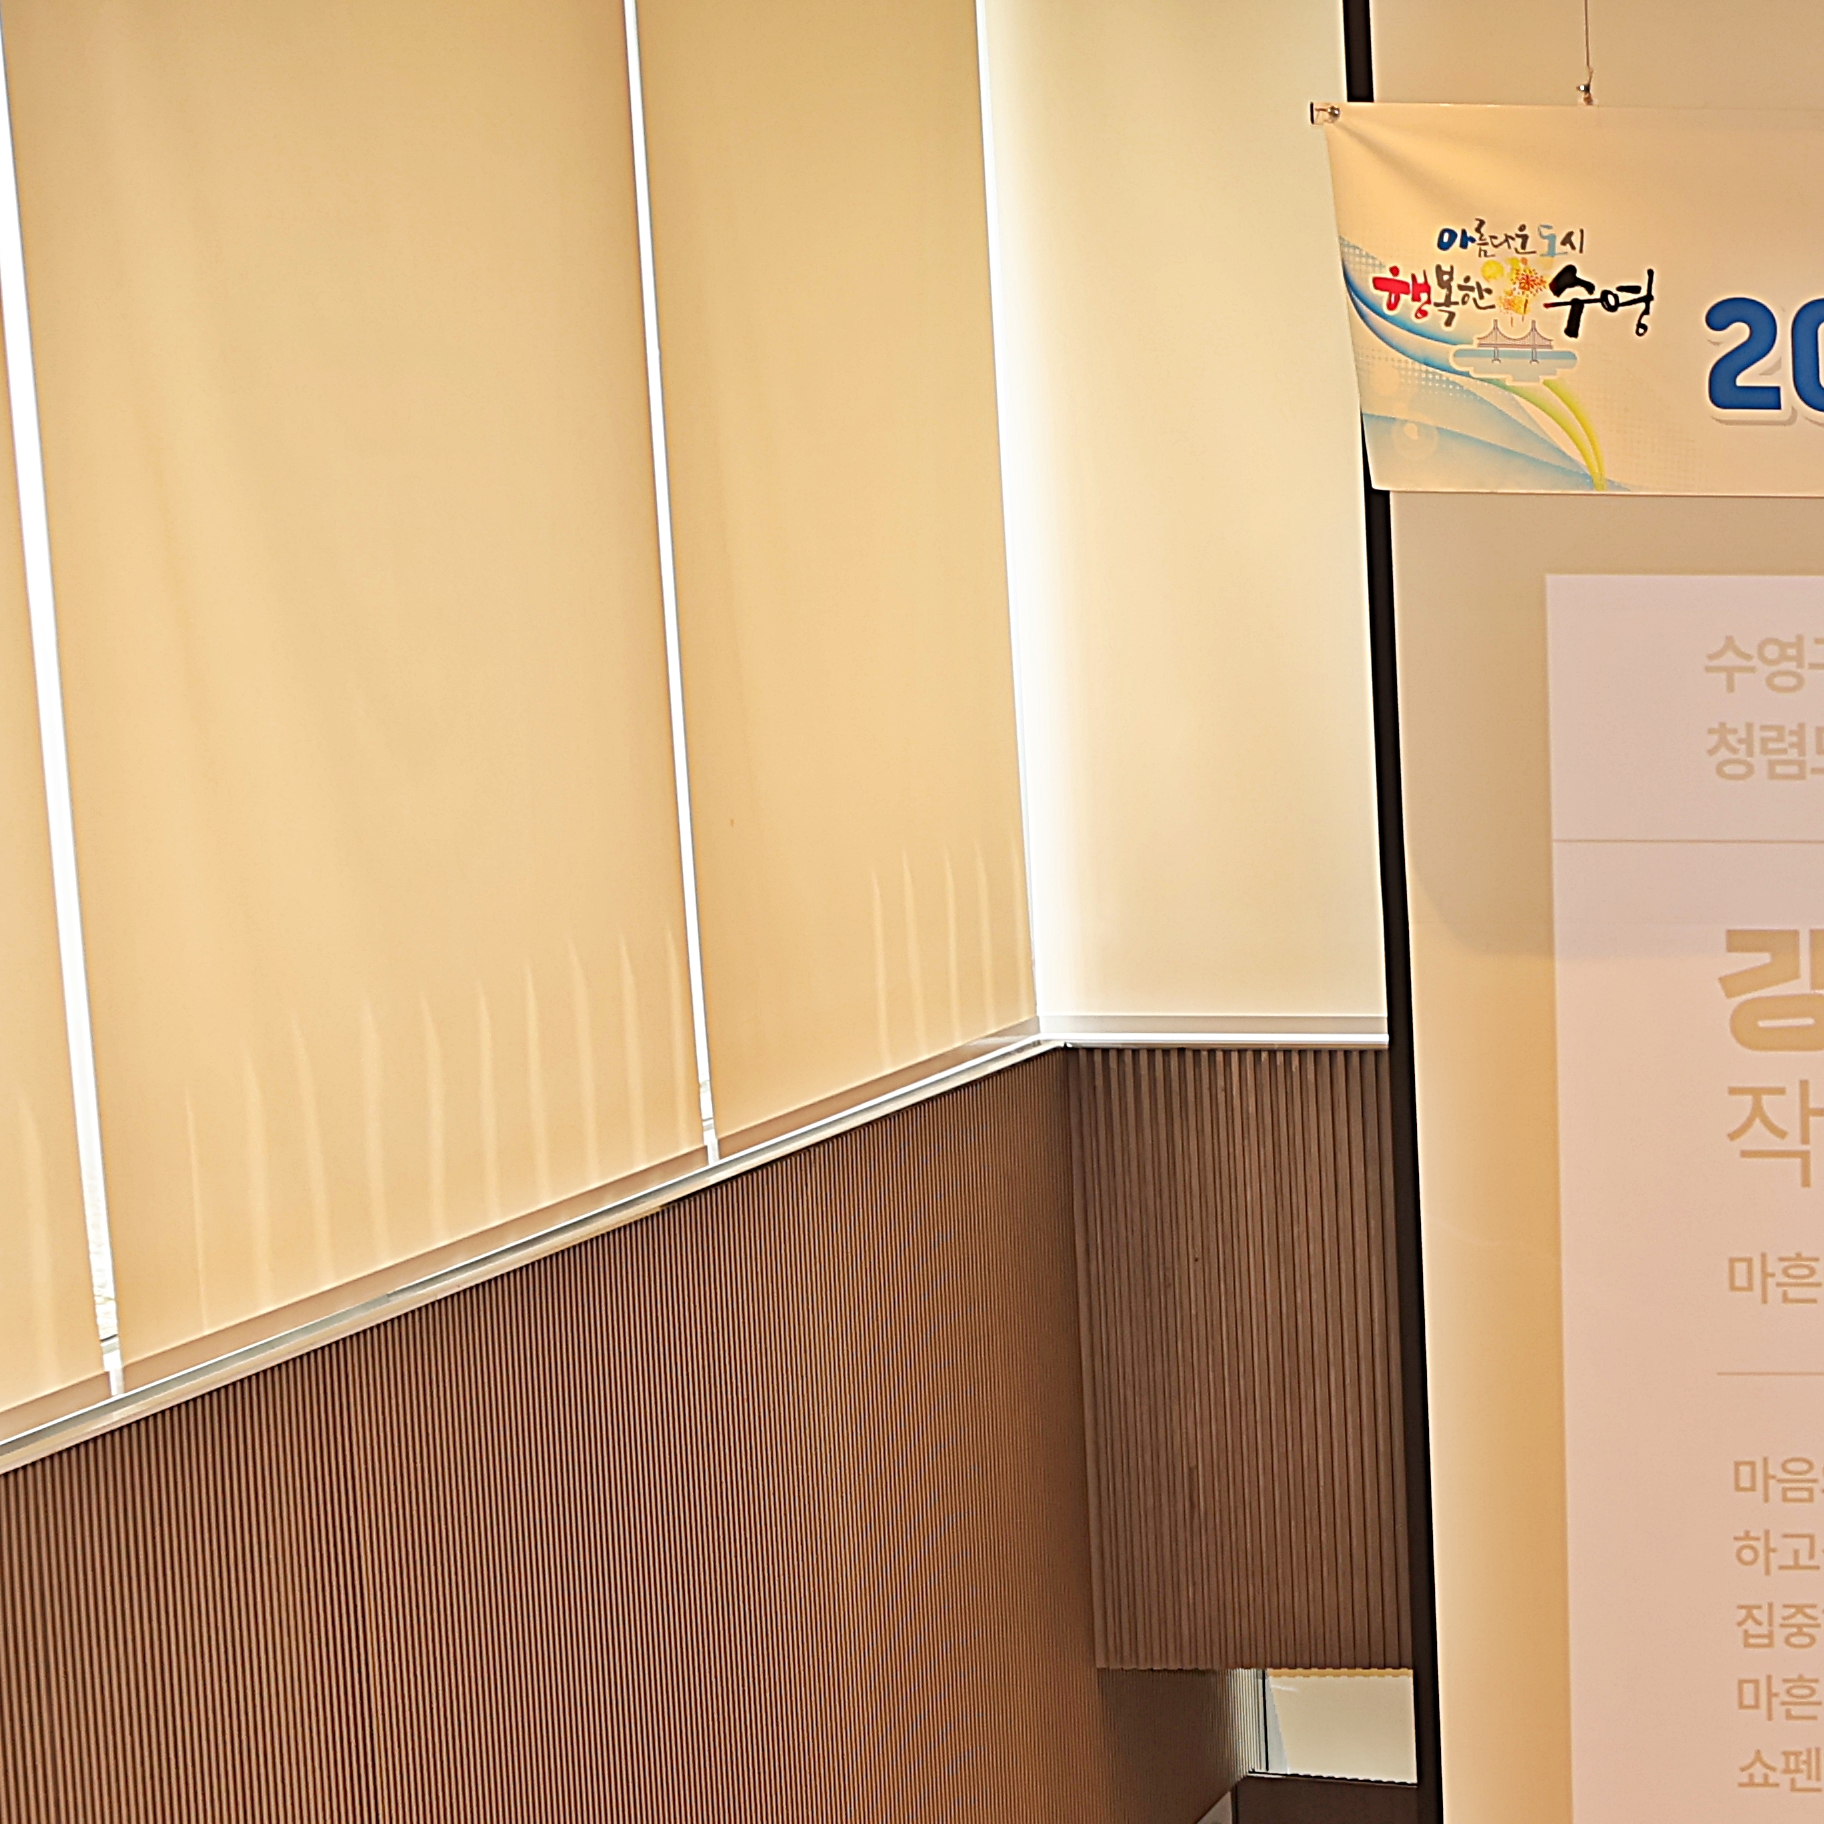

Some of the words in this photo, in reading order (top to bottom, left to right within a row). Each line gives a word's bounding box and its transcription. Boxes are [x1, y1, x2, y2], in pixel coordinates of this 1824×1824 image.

[1436, 217, 1537, 259] 아름다운
[1537, 224, 1585, 258] 도시
[1372, 263, 1495, 328] 행복한
[1543, 264, 1654, 338] 수영
